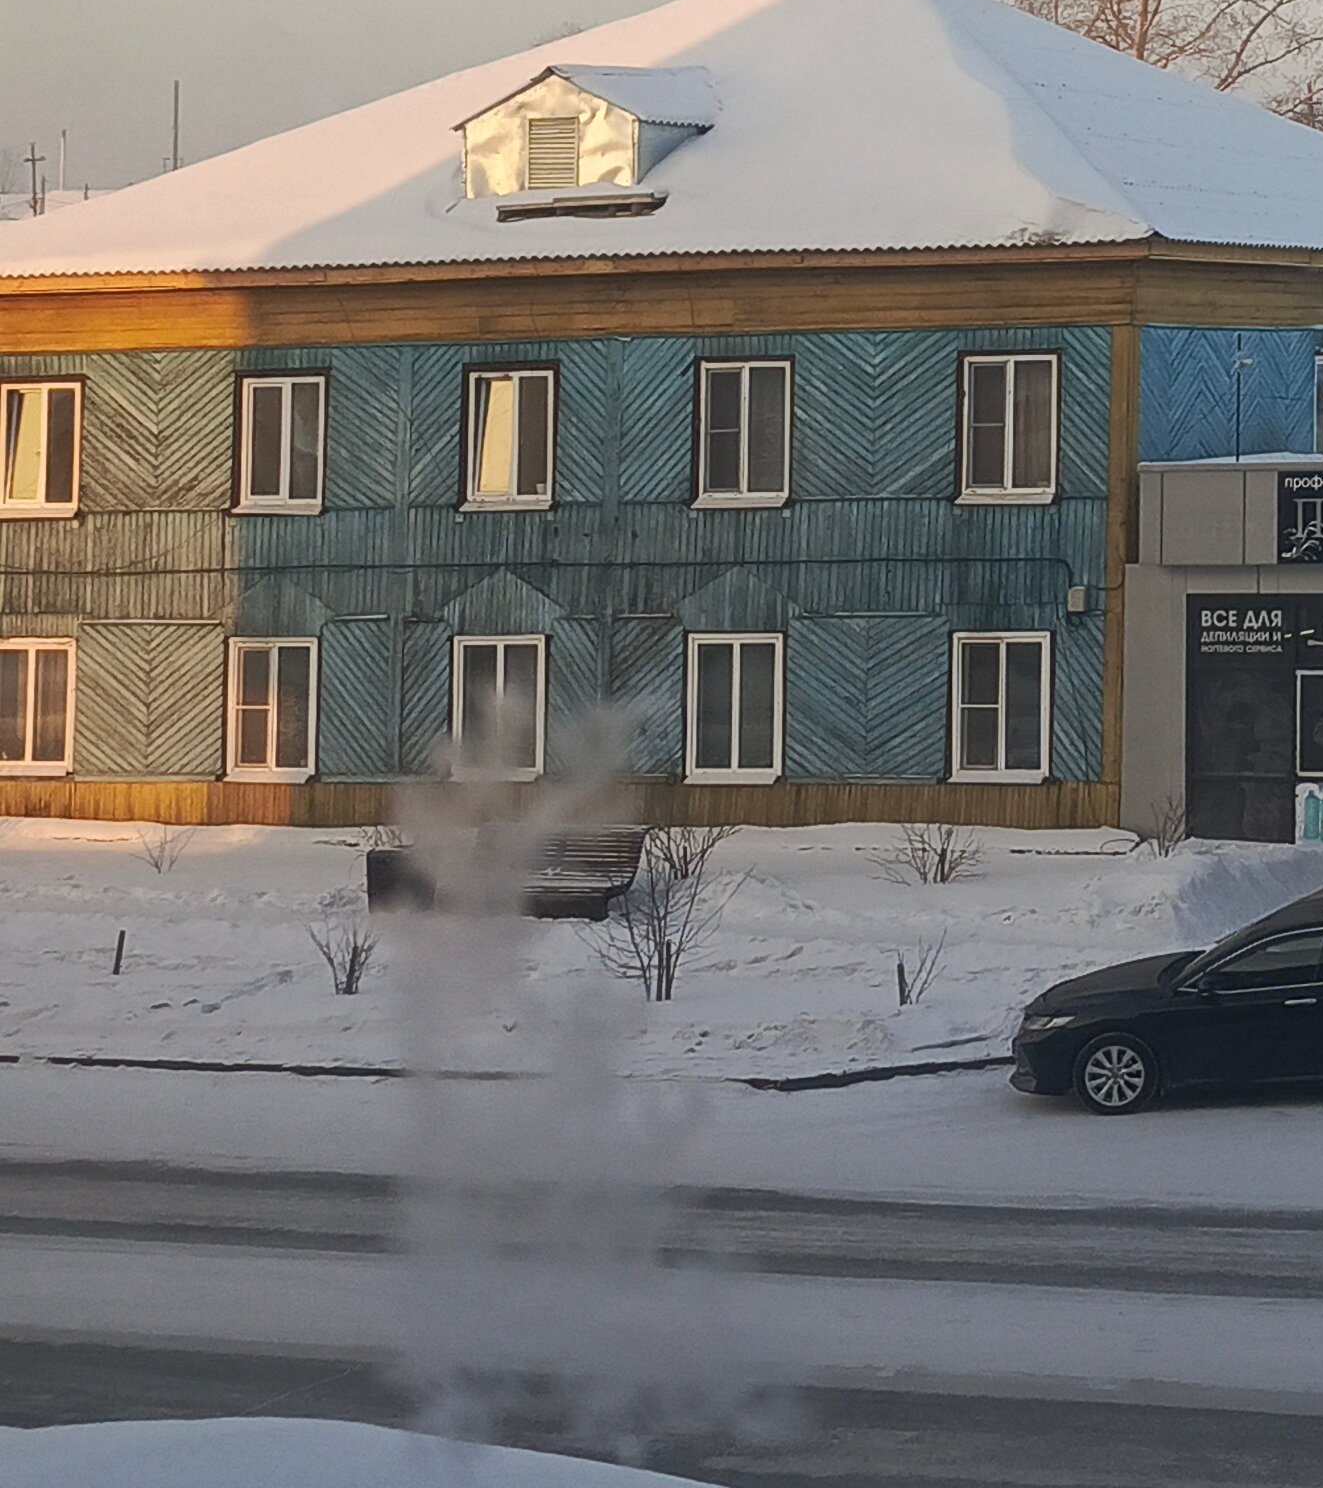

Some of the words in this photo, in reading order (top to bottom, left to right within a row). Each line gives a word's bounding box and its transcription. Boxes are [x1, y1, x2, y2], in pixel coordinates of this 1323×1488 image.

[1201, 610, 1238, 627] ВСЕ
[1243, 610, 1282, 630] ДЛЯ
[1201, 631, 1269, 643] ДЕПИЛЯЦИИ
[1272, 631, 1282, 642] И
